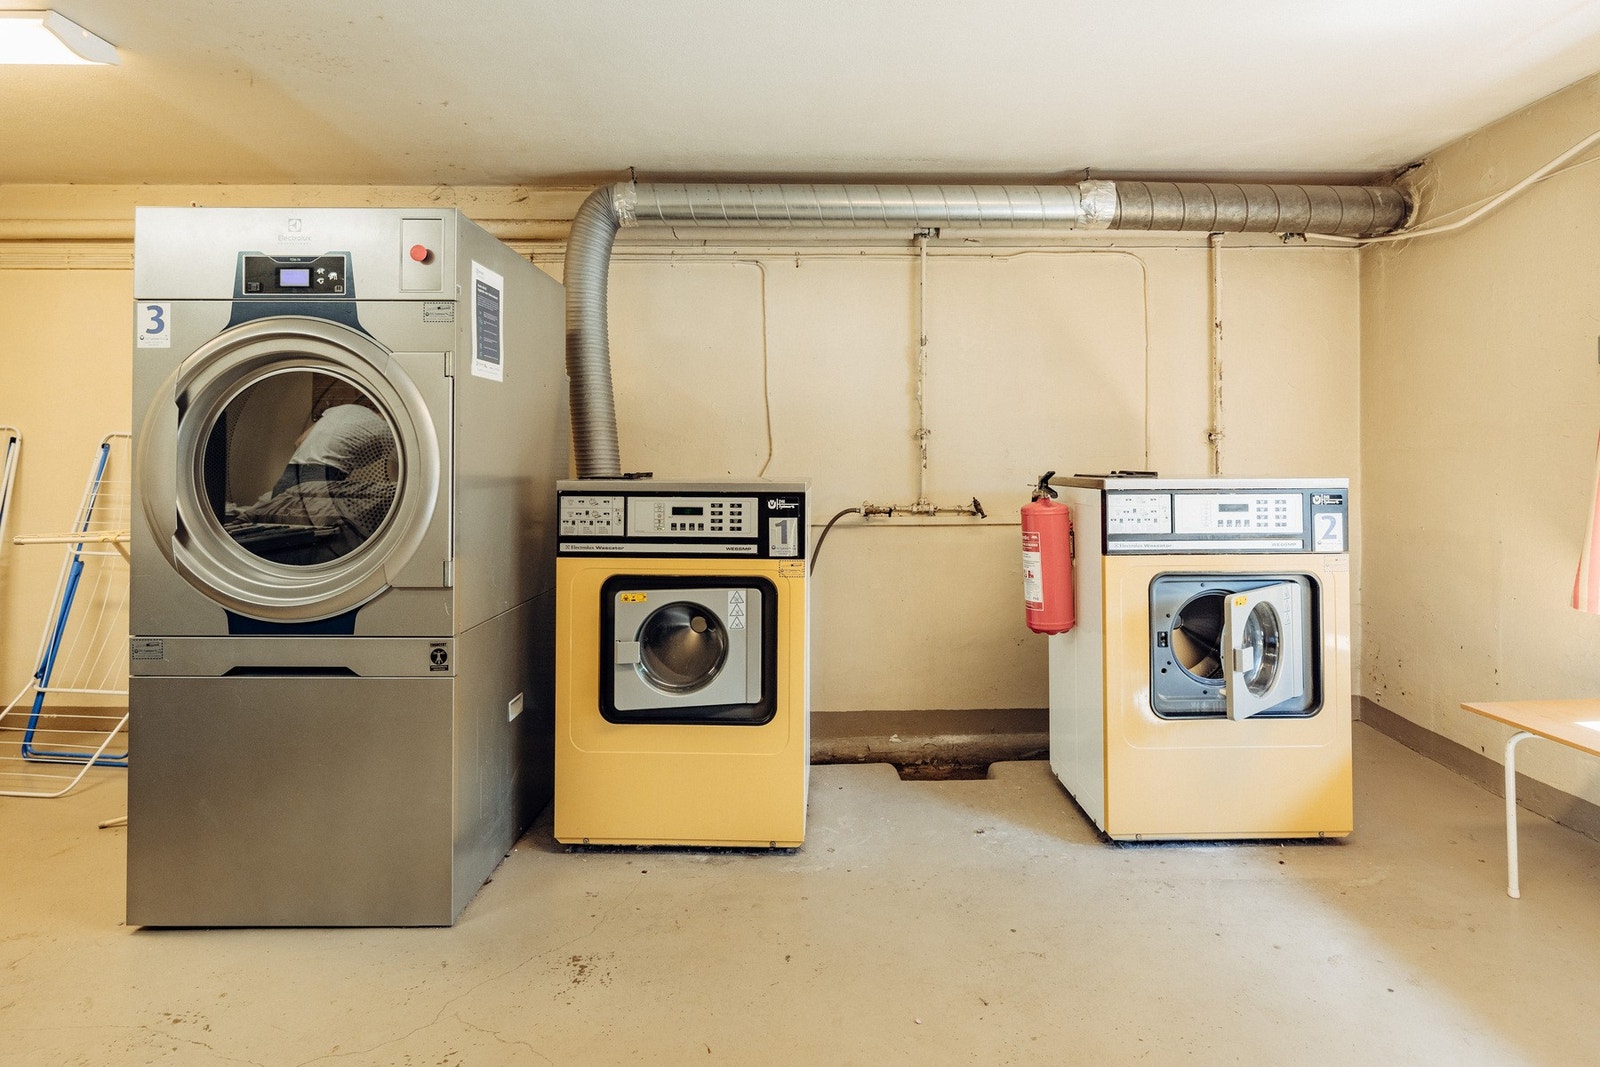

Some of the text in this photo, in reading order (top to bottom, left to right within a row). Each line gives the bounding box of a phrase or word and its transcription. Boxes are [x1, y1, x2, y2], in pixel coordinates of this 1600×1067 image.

[145, 305, 165, 335] 3
[775, 519, 788, 545] 1
[1321, 515, 1338, 540] 2
